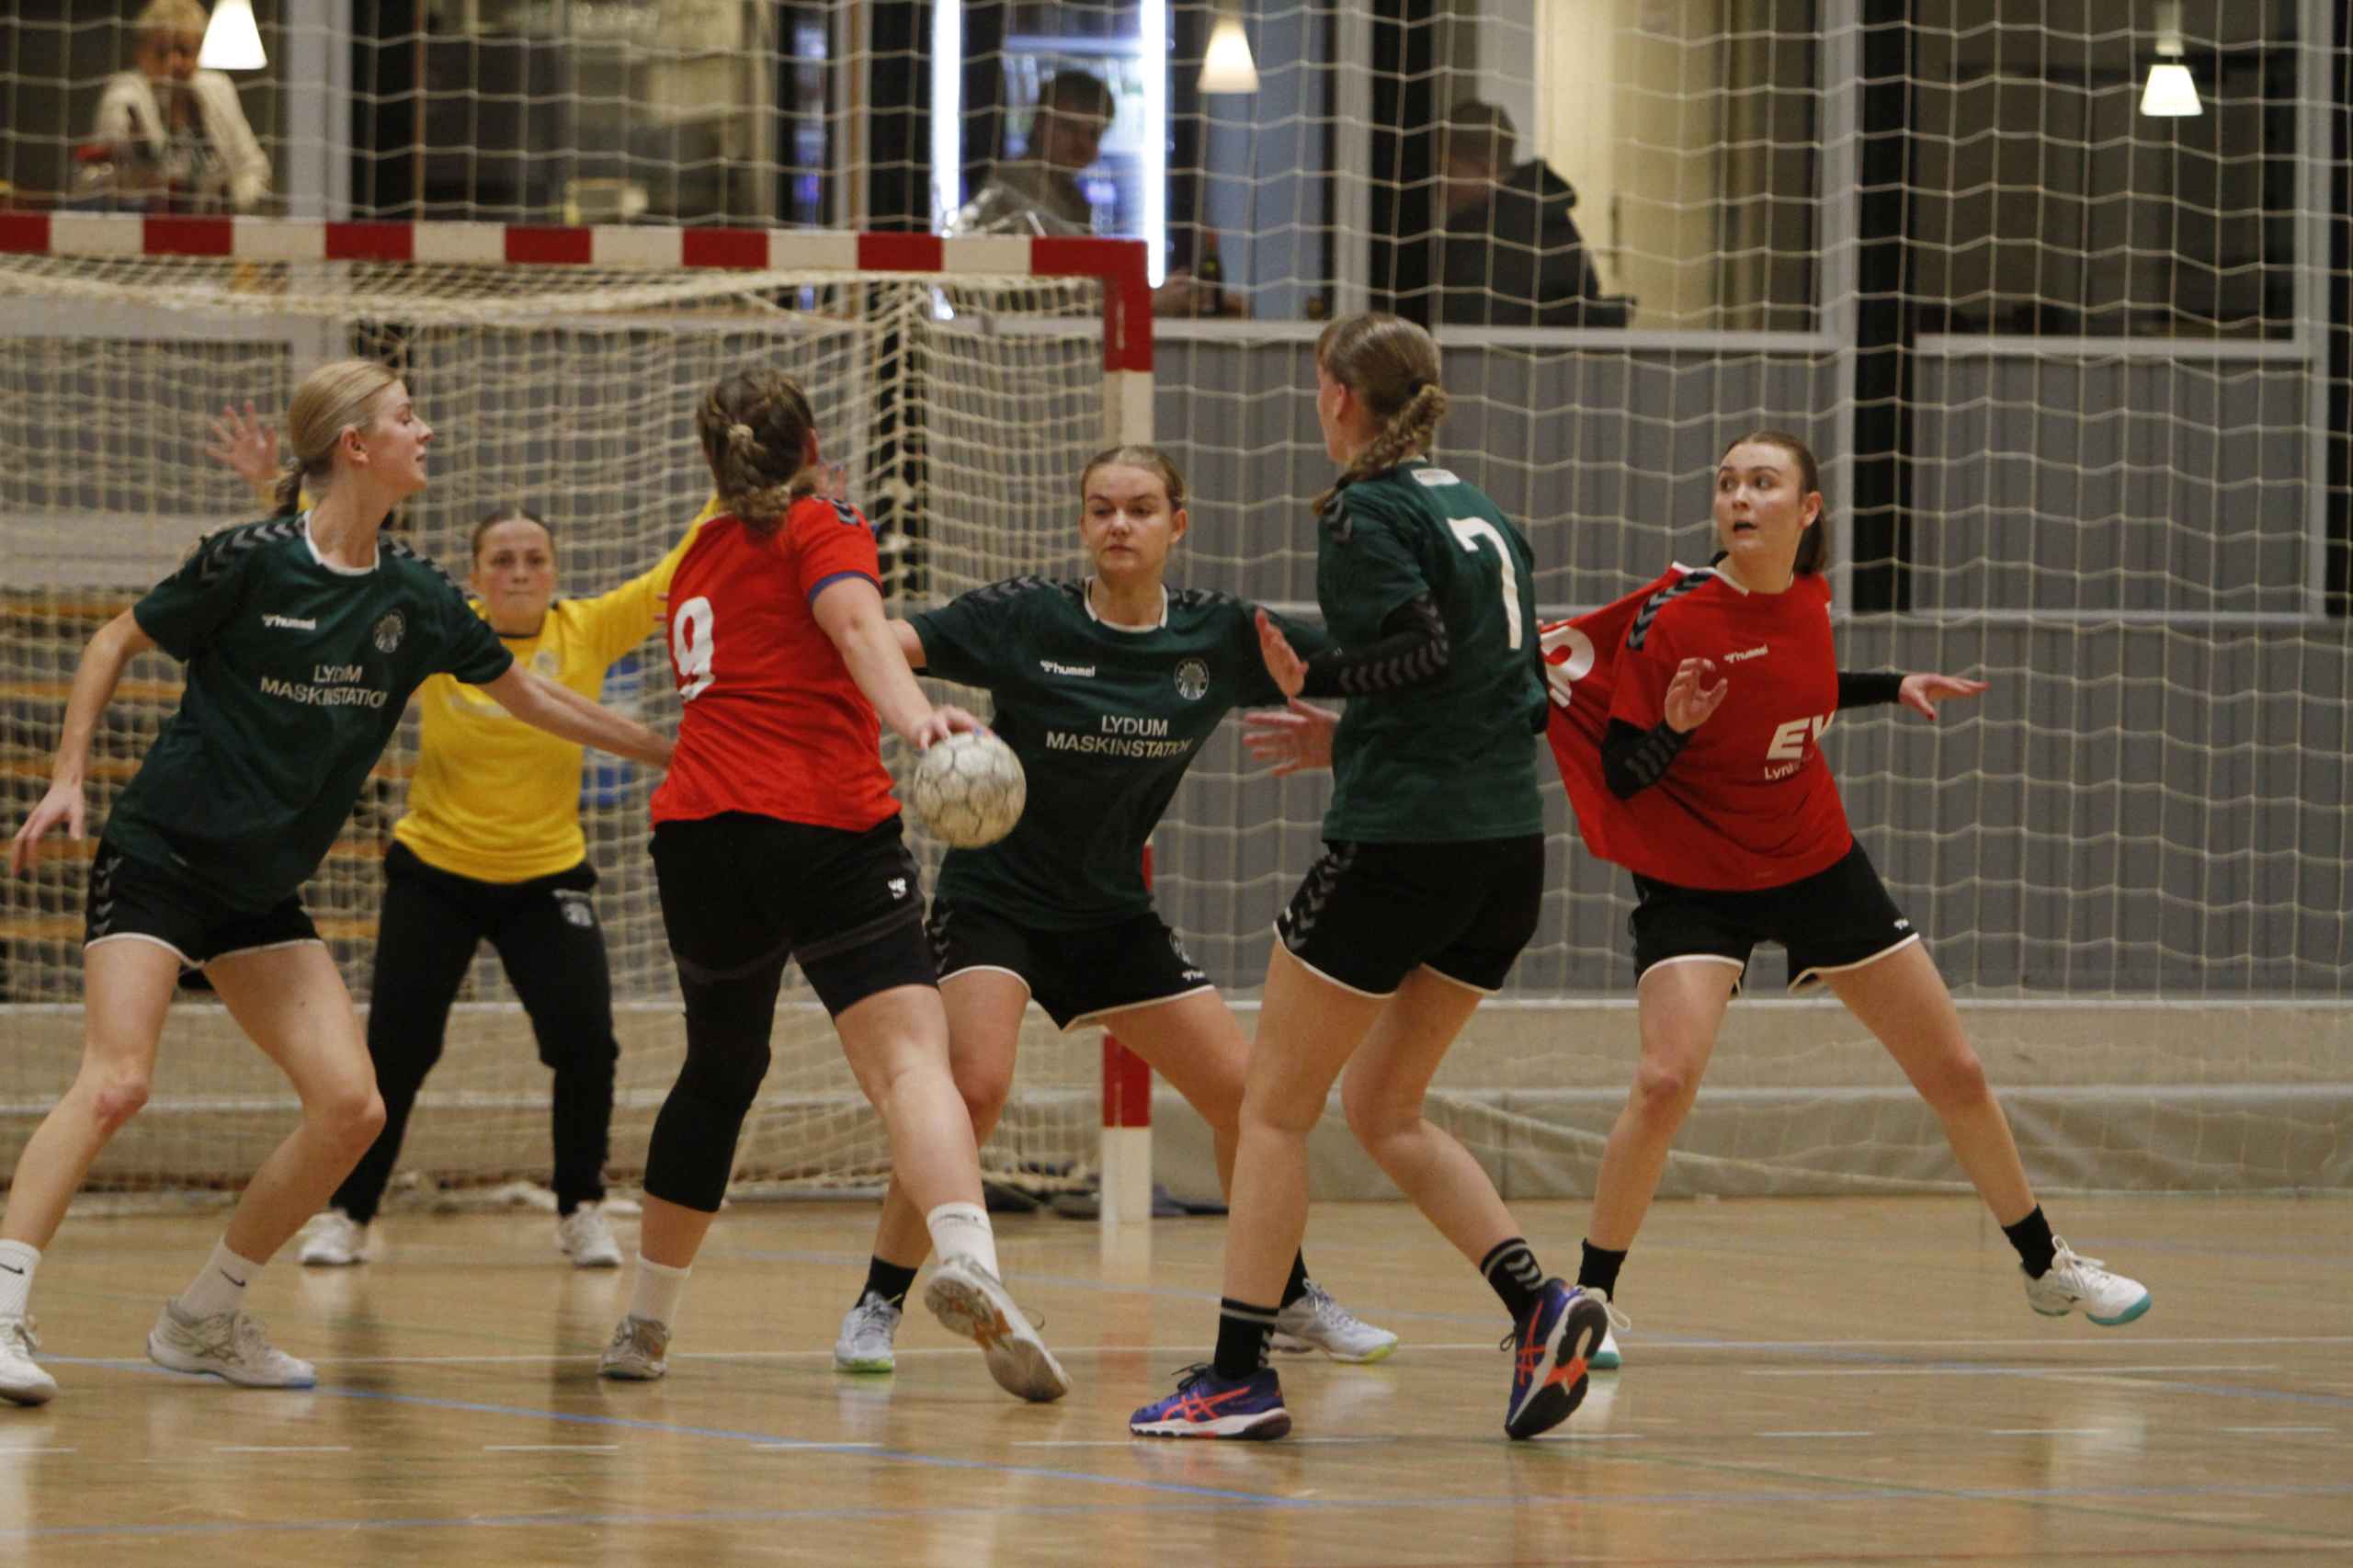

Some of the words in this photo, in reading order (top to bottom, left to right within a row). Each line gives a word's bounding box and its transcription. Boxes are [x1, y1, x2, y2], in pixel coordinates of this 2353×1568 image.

[1447, 517, 1522, 650] 7
[674, 596, 716, 701] 9
[313, 665, 363, 683] LYDM
[1053, 661, 1096, 677] hummel
[1101, 715, 1168, 736] LYDUM
